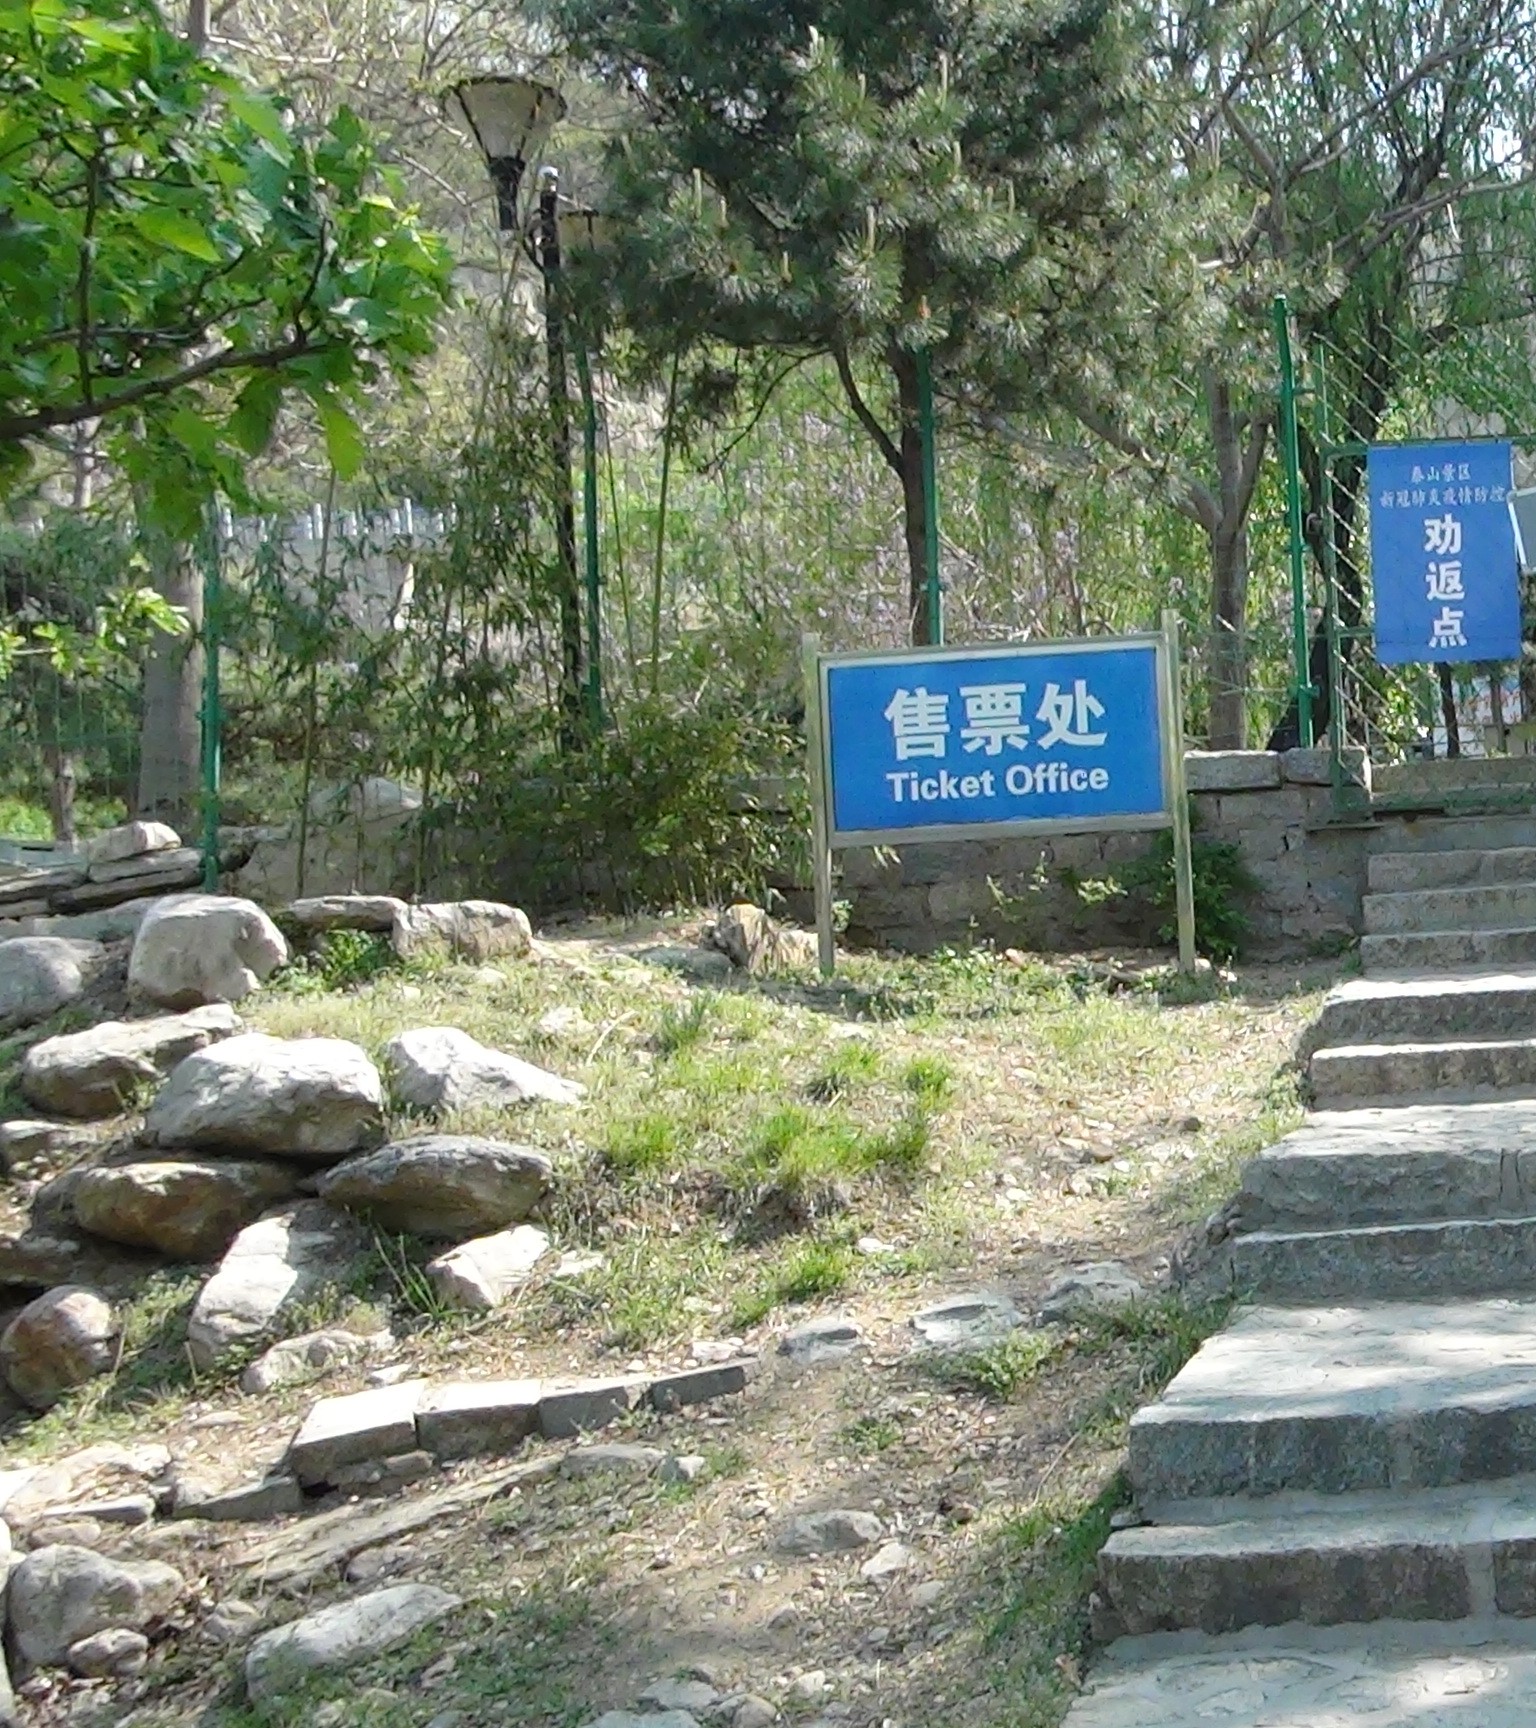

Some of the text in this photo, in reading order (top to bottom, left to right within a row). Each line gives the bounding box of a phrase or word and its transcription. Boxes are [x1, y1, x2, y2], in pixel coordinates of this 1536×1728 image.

[1411, 463, 1471, 483] 泰山景区
[1423, 513, 1468, 649] 劝返点
[883, 679, 1107, 761] 售票处
[887, 762, 1109, 802] Ticket Office
